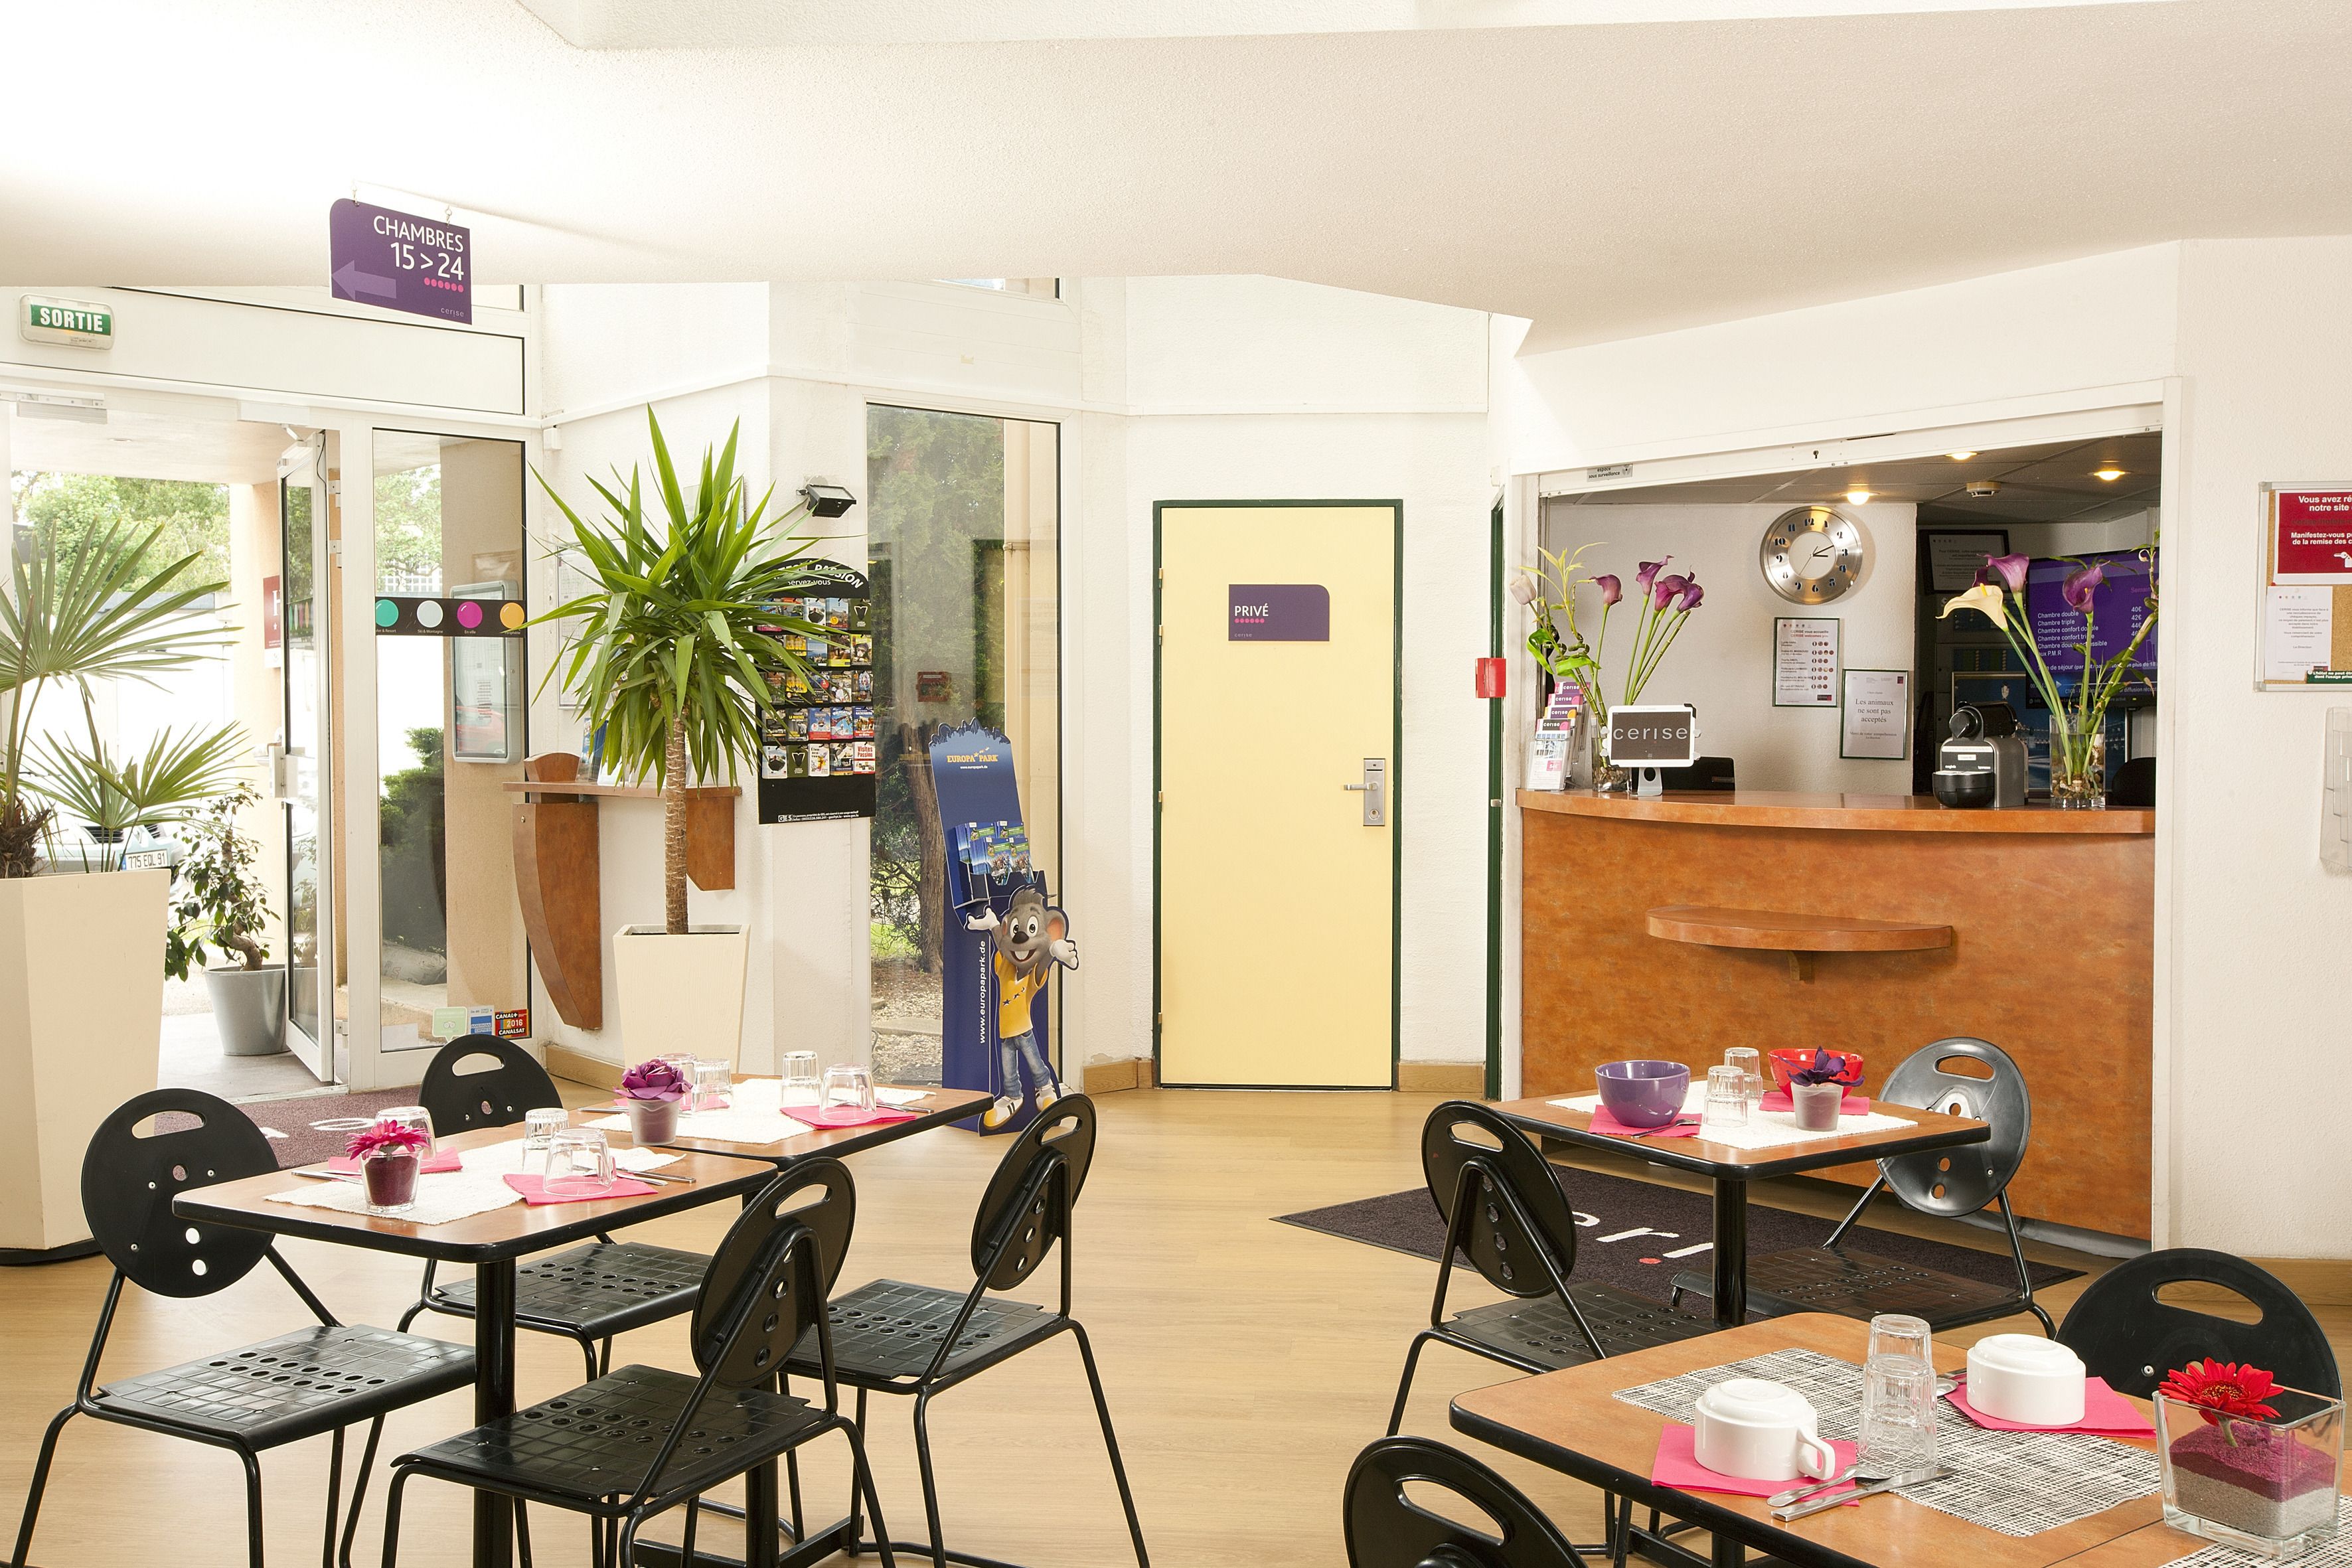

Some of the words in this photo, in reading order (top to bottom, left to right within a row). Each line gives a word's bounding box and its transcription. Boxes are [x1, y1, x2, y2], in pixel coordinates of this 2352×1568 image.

[373, 215, 464, 253] CHAMBRES
[390, 242, 415, 270] 15
[437, 252, 464, 281] 24
[441, 307, 464, 317] cerise
[40, 307, 103, 332] SORTIE
[1804, 518, 1815, 526] 12
[1812, 584, 1819, 593] 6
[1234, 603, 1269, 617] PRIVÉ
[1612, 728, 1688, 741] cerise
[947, 754, 975, 763] EUROPA
[979, 753, 998, 762] PARK
[128, 855, 141, 868] 775
[157, 852, 165, 865] 91
